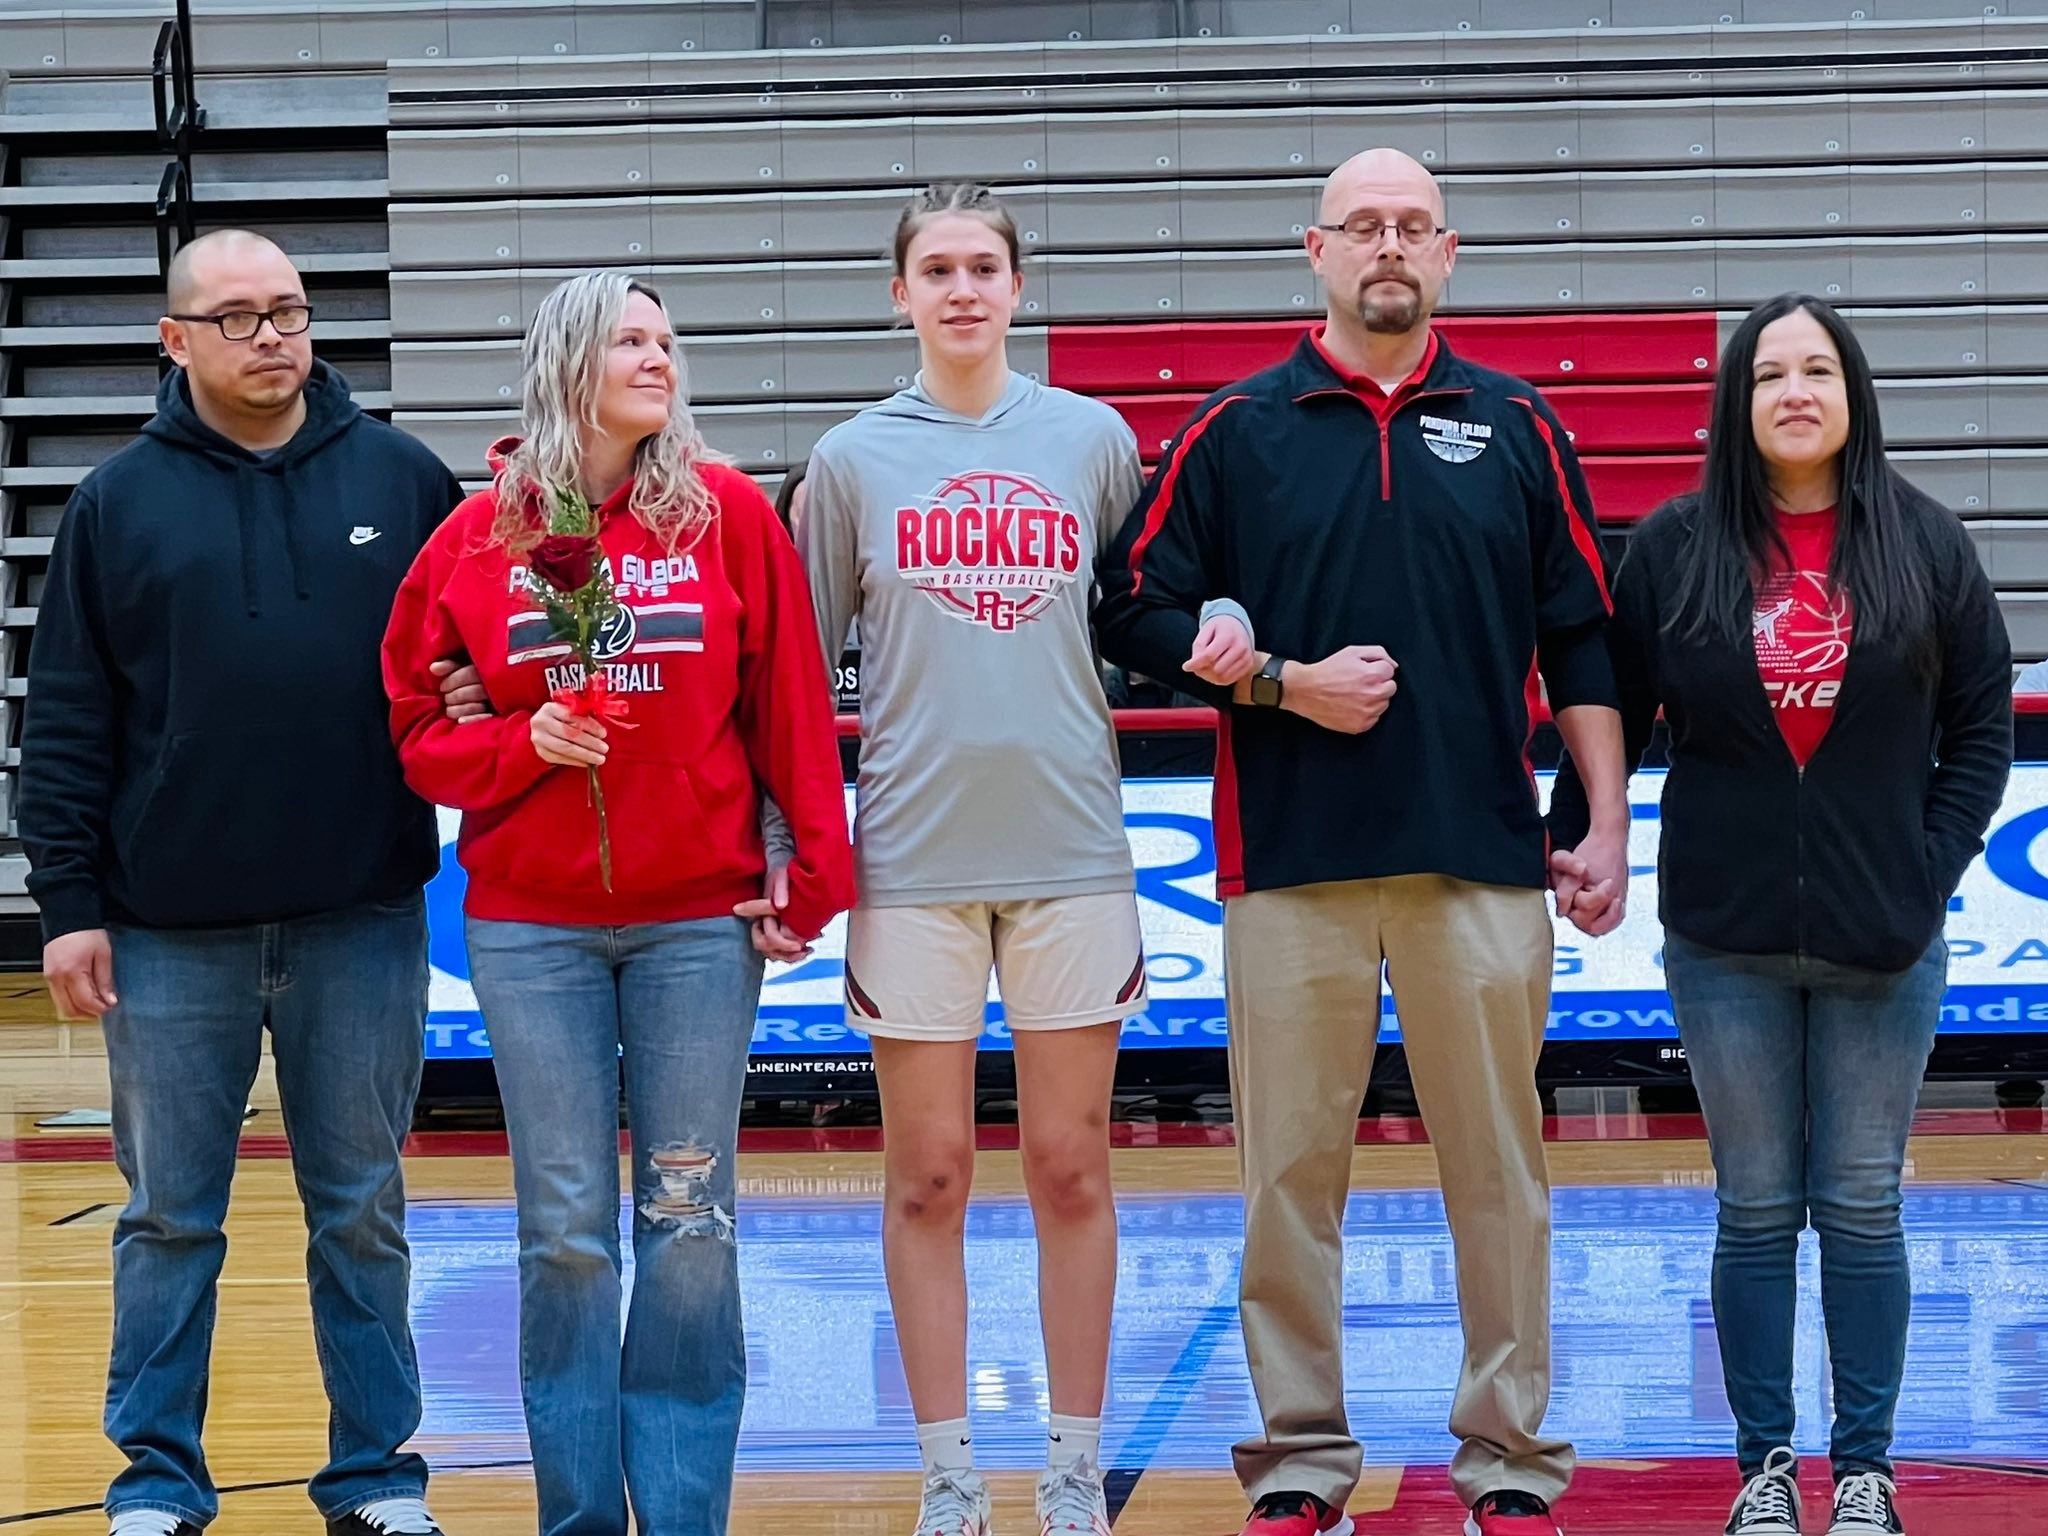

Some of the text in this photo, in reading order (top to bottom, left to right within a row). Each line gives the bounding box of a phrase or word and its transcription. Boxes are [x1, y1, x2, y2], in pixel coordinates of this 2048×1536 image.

[896, 506, 1081, 574] ROCKETS
[621, 553, 700, 587] GILBOA
[942, 573, 1045, 586] BASKETBALL
[973, 590, 1015, 632] PG
[544, 663, 664, 699] BASKTBALL
[746, 1061, 876, 1074] LINEINTERACTI
